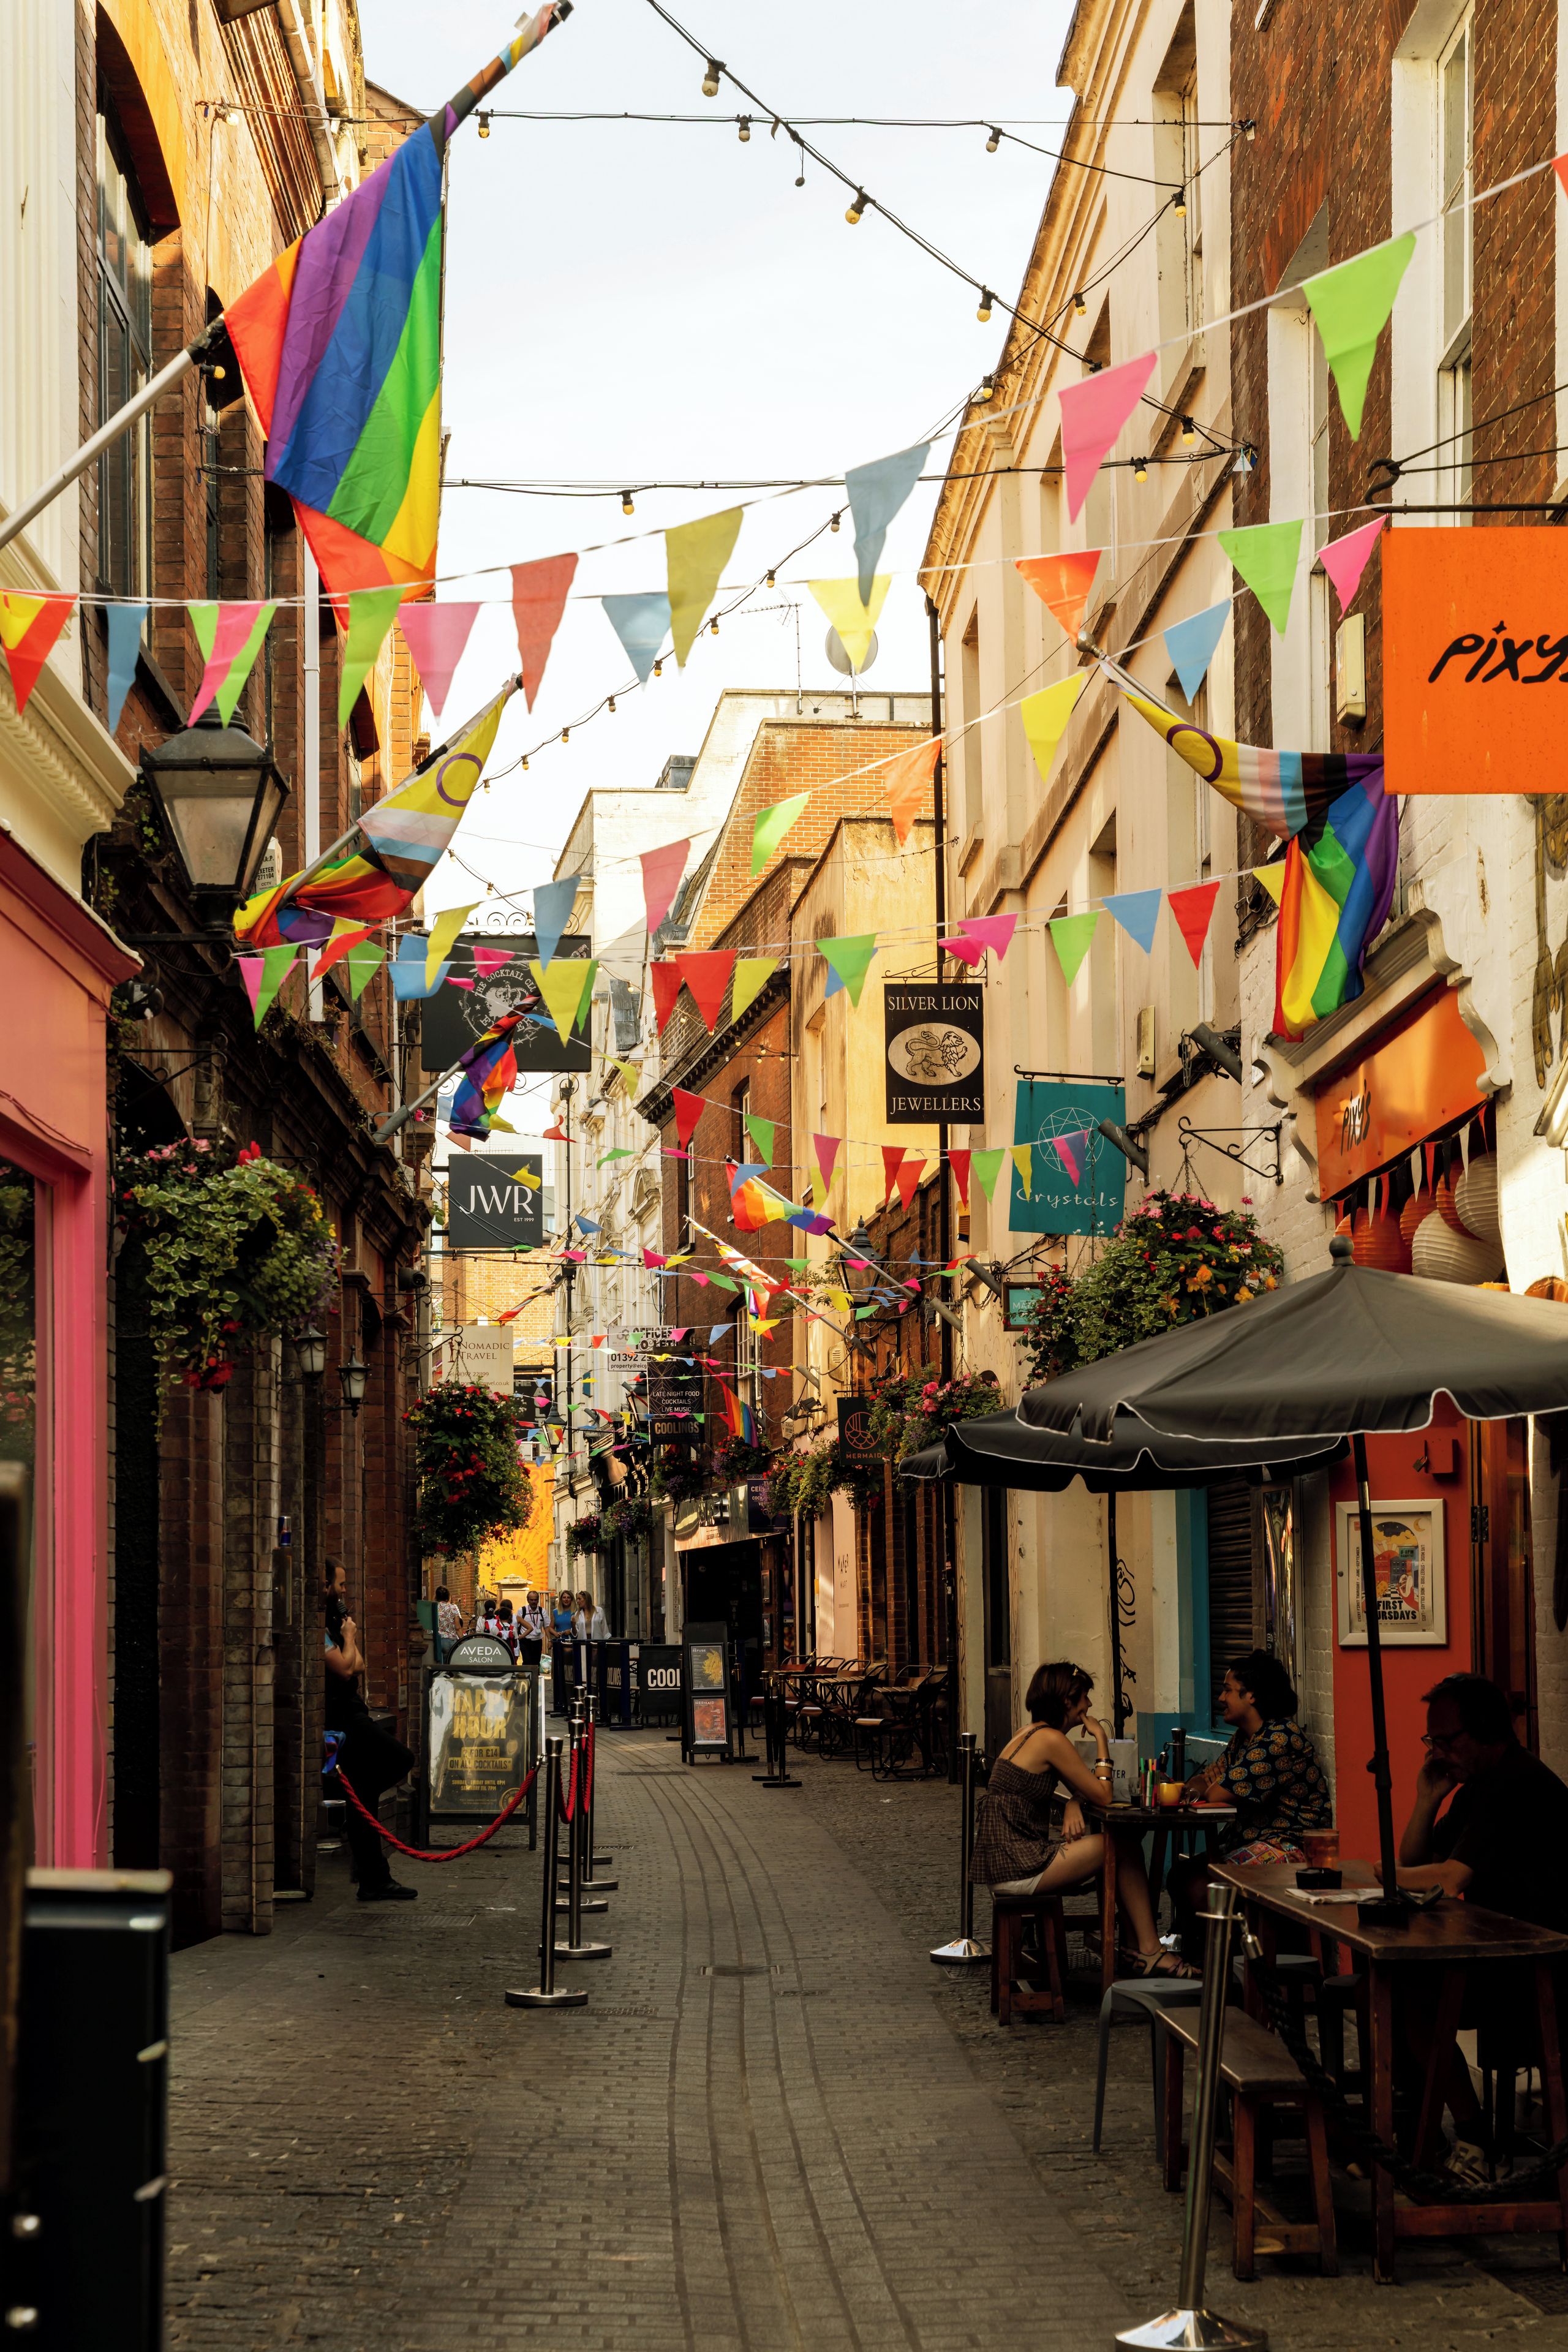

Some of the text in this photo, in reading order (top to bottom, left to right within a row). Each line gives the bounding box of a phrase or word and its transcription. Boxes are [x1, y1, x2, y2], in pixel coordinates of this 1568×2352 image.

[475, 970, 537, 997] THE COCKTAIL CLU
[888, 996, 979, 1011] SILVER LION
[890, 1097, 981, 1115] JEWELLERS
[459, 1185, 533, 1214] JWR
[1016, 1187, 1118, 1208] Crystals
[633, 1327, 673, 1338] OFFICES
[611, 1353, 638, 1362] 01392
[655, 1421, 699, 1434] COOLINGS
[1377, 1600, 1403, 1610] FIRST
[460, 1646, 502, 1656] AVEDA
[448, 1689, 514, 1713] HAPPY
[453, 1715, 507, 1739] HOUR
[470, 1749, 483, 1757] FOR
[486, 1749, 498, 1757] £14
[450, 1760, 459, 1768] ON
[461, 1760, 472, 1769] ALL
